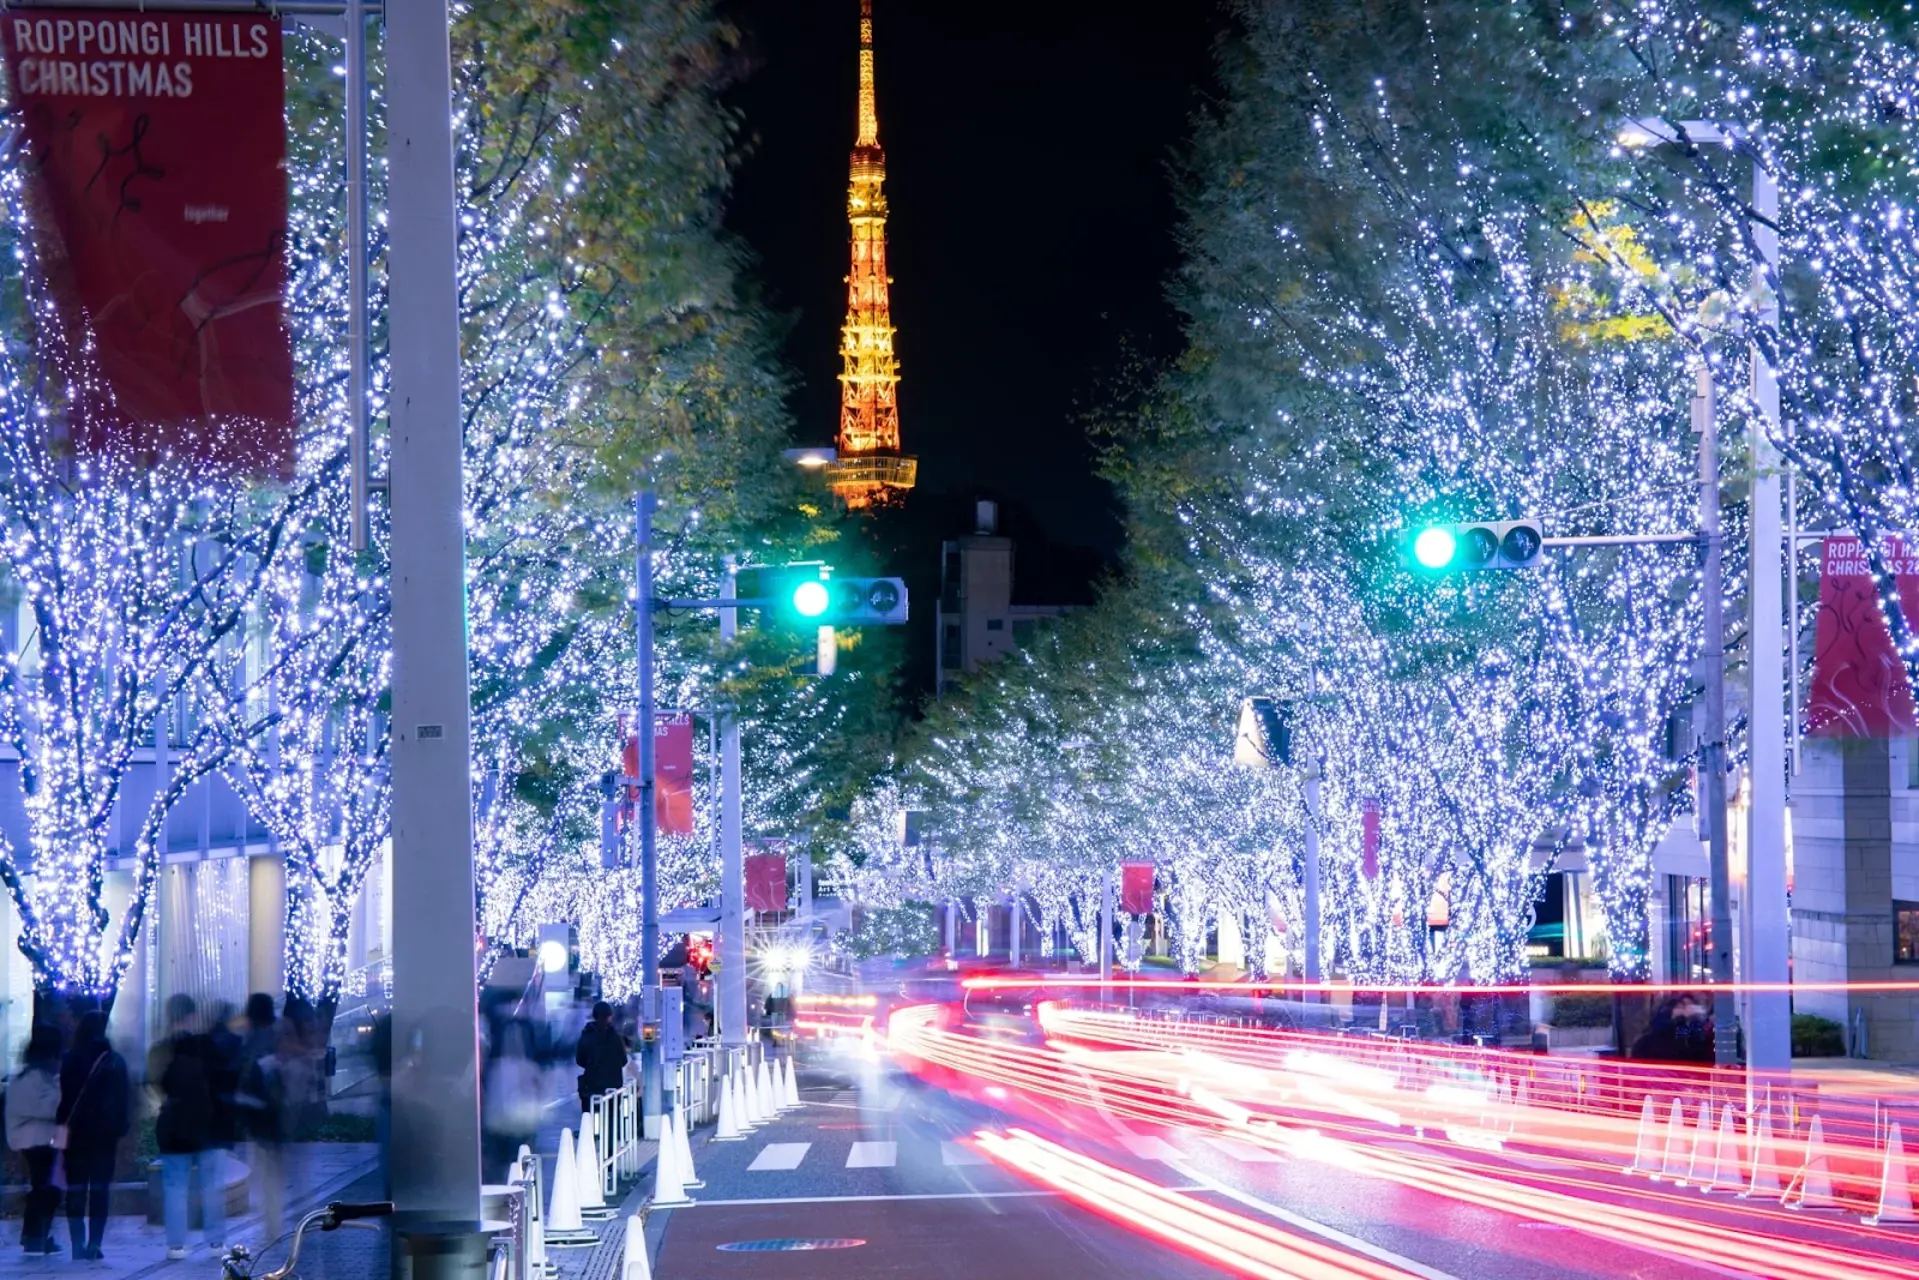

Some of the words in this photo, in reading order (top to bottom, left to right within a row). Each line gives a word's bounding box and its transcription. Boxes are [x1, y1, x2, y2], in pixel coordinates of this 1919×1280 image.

[13, 18, 170, 56] ROPPONGI
[184, 23, 269, 58] HILLS
[19, 58, 193, 97] CHRISTMAS
[1828, 542, 1896, 558] ROPPGI
[1827, 560, 1903, 575] CHRISS
